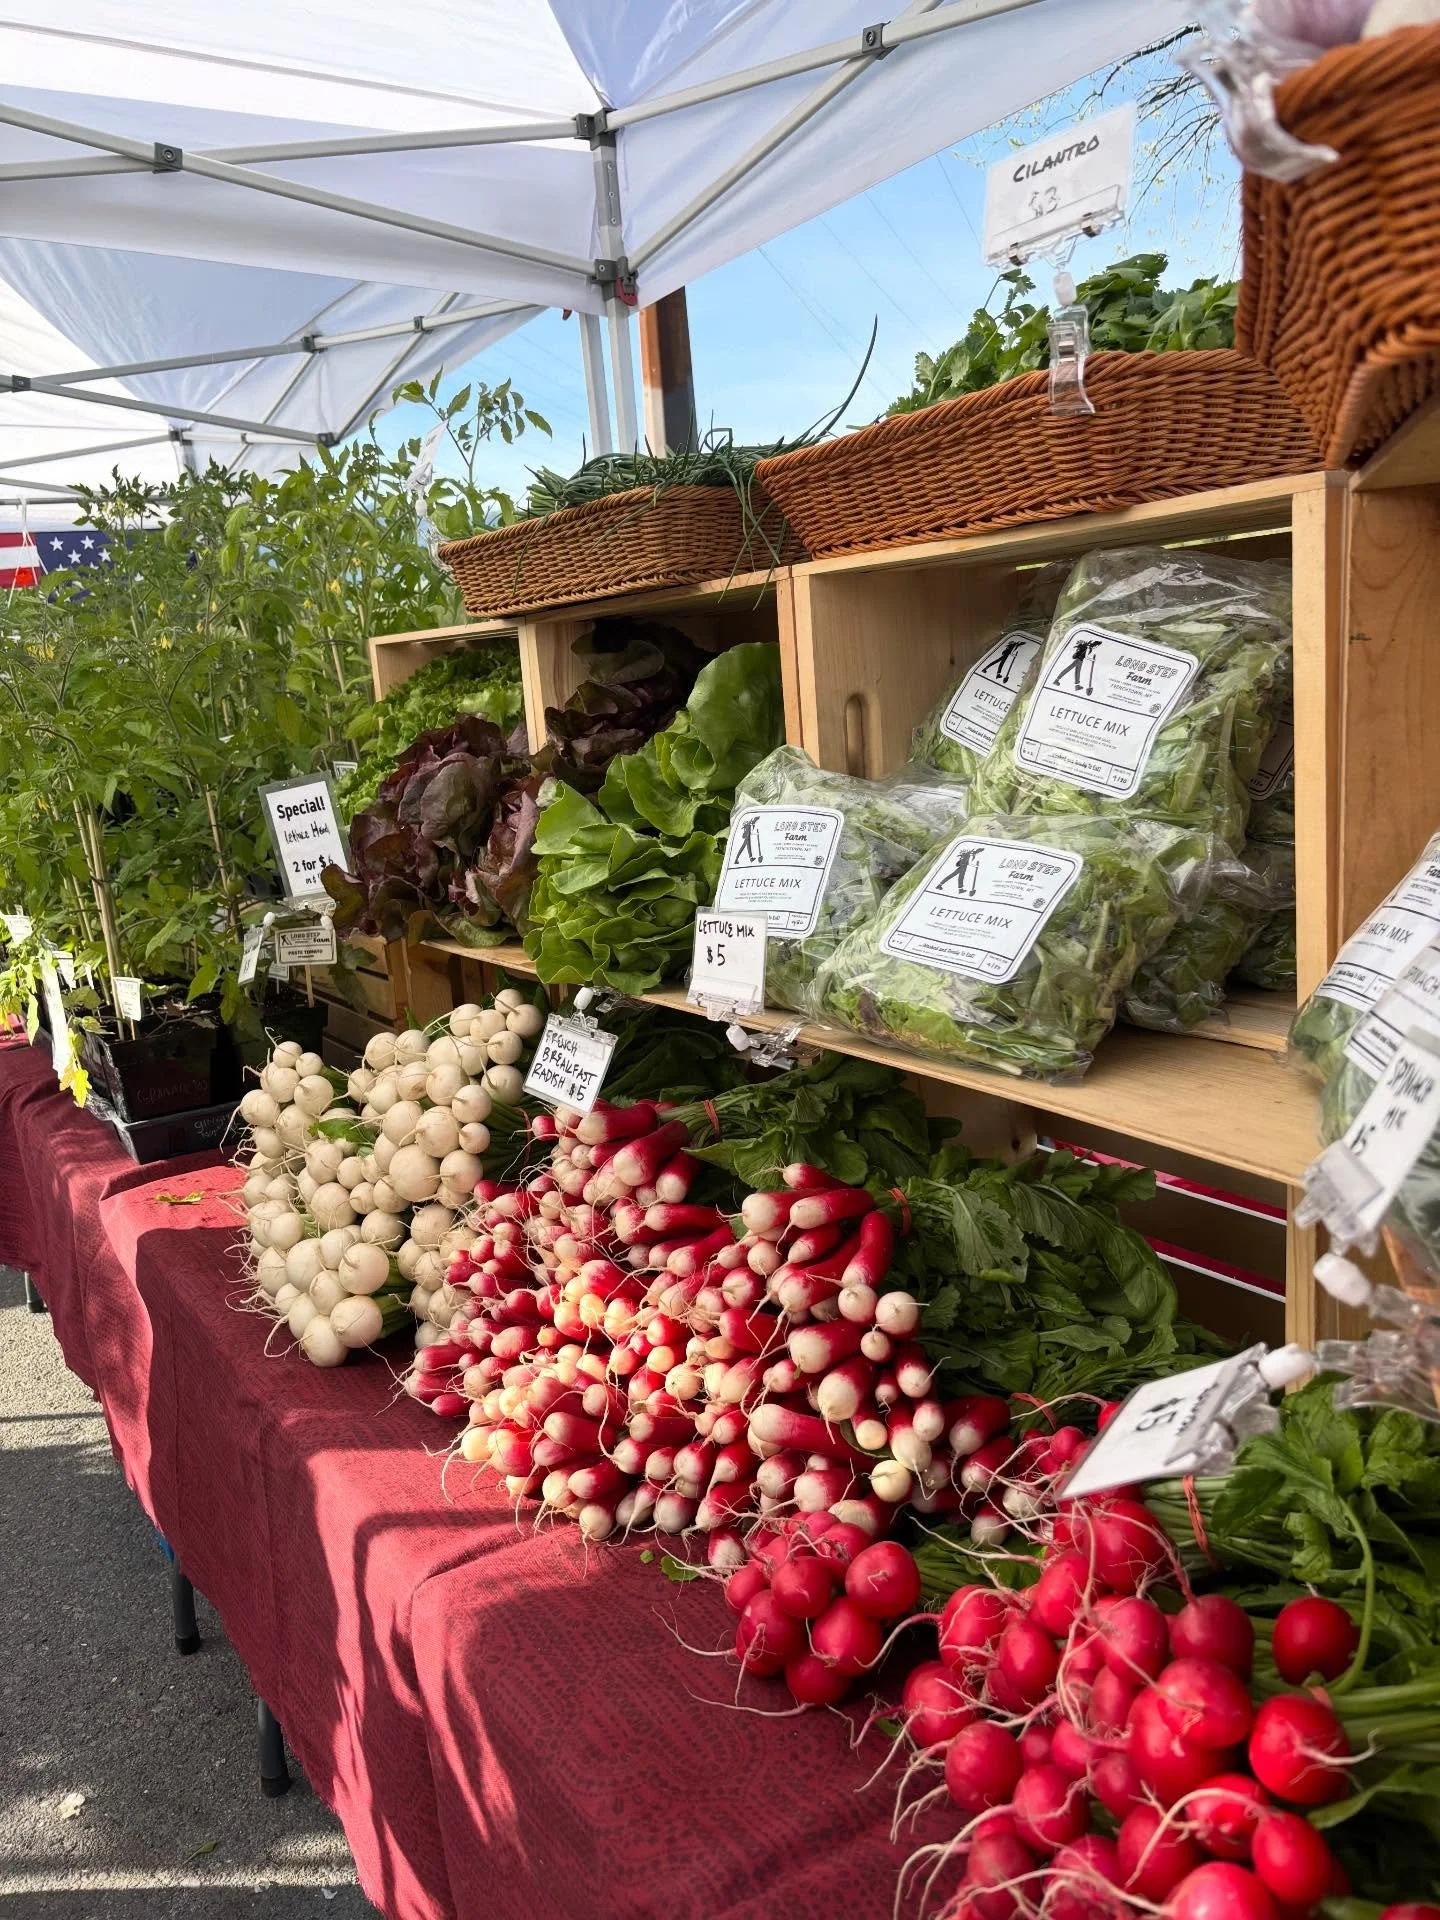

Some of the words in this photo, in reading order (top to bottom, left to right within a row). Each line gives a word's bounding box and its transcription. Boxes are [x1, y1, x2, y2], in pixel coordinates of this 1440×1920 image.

[1012, 135, 1100, 183] CILANTRO
[1029, 186, 1062, 217] $3
[1115, 655, 1148, 672] LONG
[1146, 663, 1179, 679] STEP
[1126, 671, 1153, 686] Farm
[973, 688, 1011, 713] LETTUCE
[1050, 705, 1103, 729] LETTUCE
[1103, 720, 1131, 737] MIX
[276, 795, 326, 822] Special!
[774, 821, 799, 832] LONG
[799, 821, 828, 833] STEP
[785, 832, 807, 841] Farm
[292, 860, 301, 873] 2
[301, 859, 317, 871] for
[998, 858, 1029, 870] LONG
[1027, 861, 1062, 876] STEP
[1008, 870, 1034, 882] Farm
[735, 877, 776, 889] LETTUCE
[778, 878, 802, 889] MIX
[698, 919, 733, 938] LETTUCE
[736, 924, 755, 938] MIX
[930, 906, 984, 924] LETTUCE
[984, 915, 1014, 929] MIX
[1387, 926, 1414, 943] MIX
[706, 943, 726, 967] $5
[545, 1029, 579, 1057] FRENCH
[542, 1046, 598, 1086] BREAKFAST
[531, 1062, 567, 1089] RADISH
[568, 1083, 586, 1101] $5
